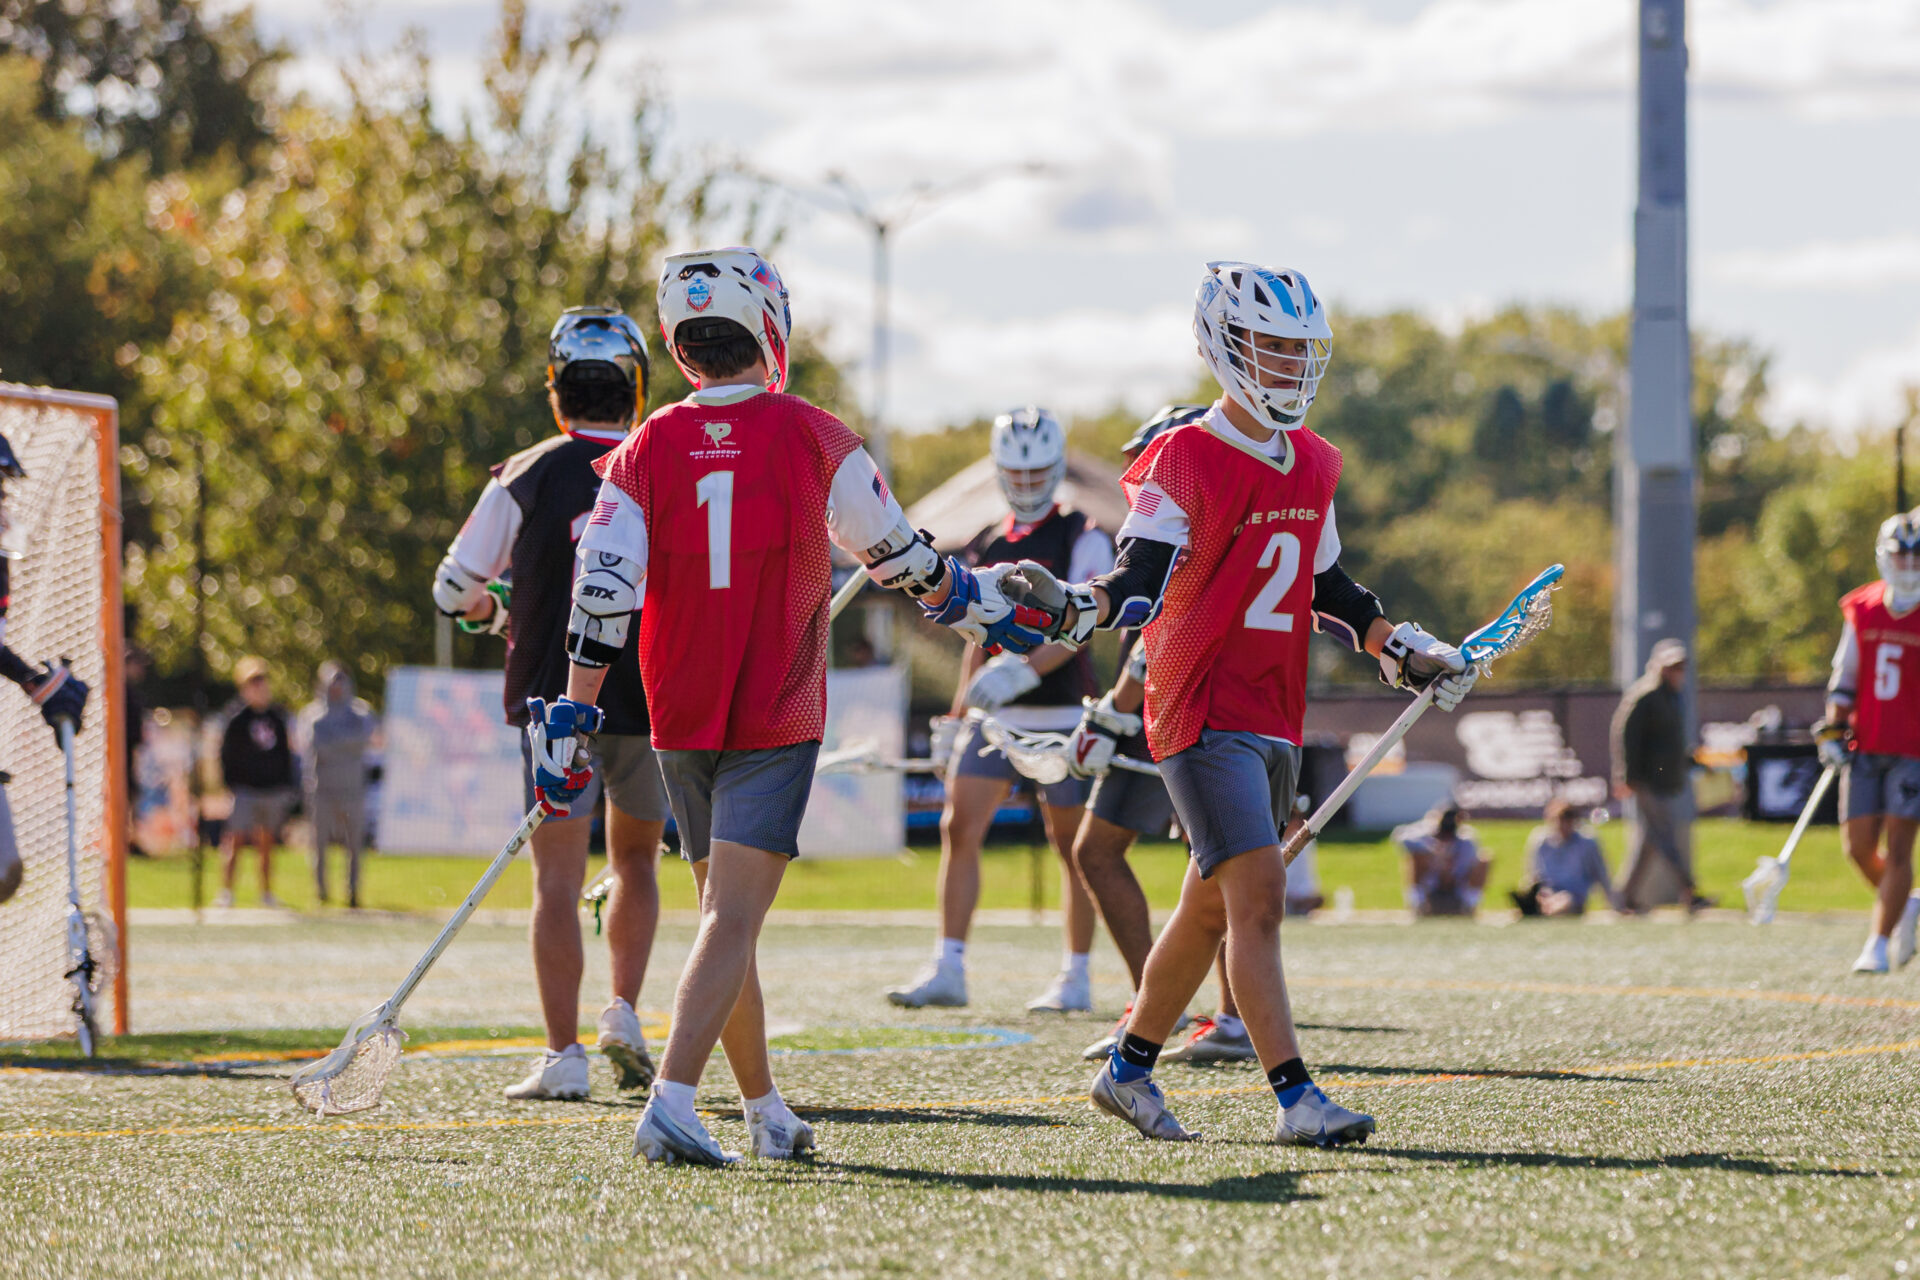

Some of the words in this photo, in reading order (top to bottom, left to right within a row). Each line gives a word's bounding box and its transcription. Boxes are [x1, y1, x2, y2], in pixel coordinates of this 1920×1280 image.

[696, 471, 734, 589] 1
[581, 585, 618, 601] STX
[881, 566, 913, 586] STX
[1244, 531, 1300, 632] 2
[1874, 643, 1904, 701] 5
